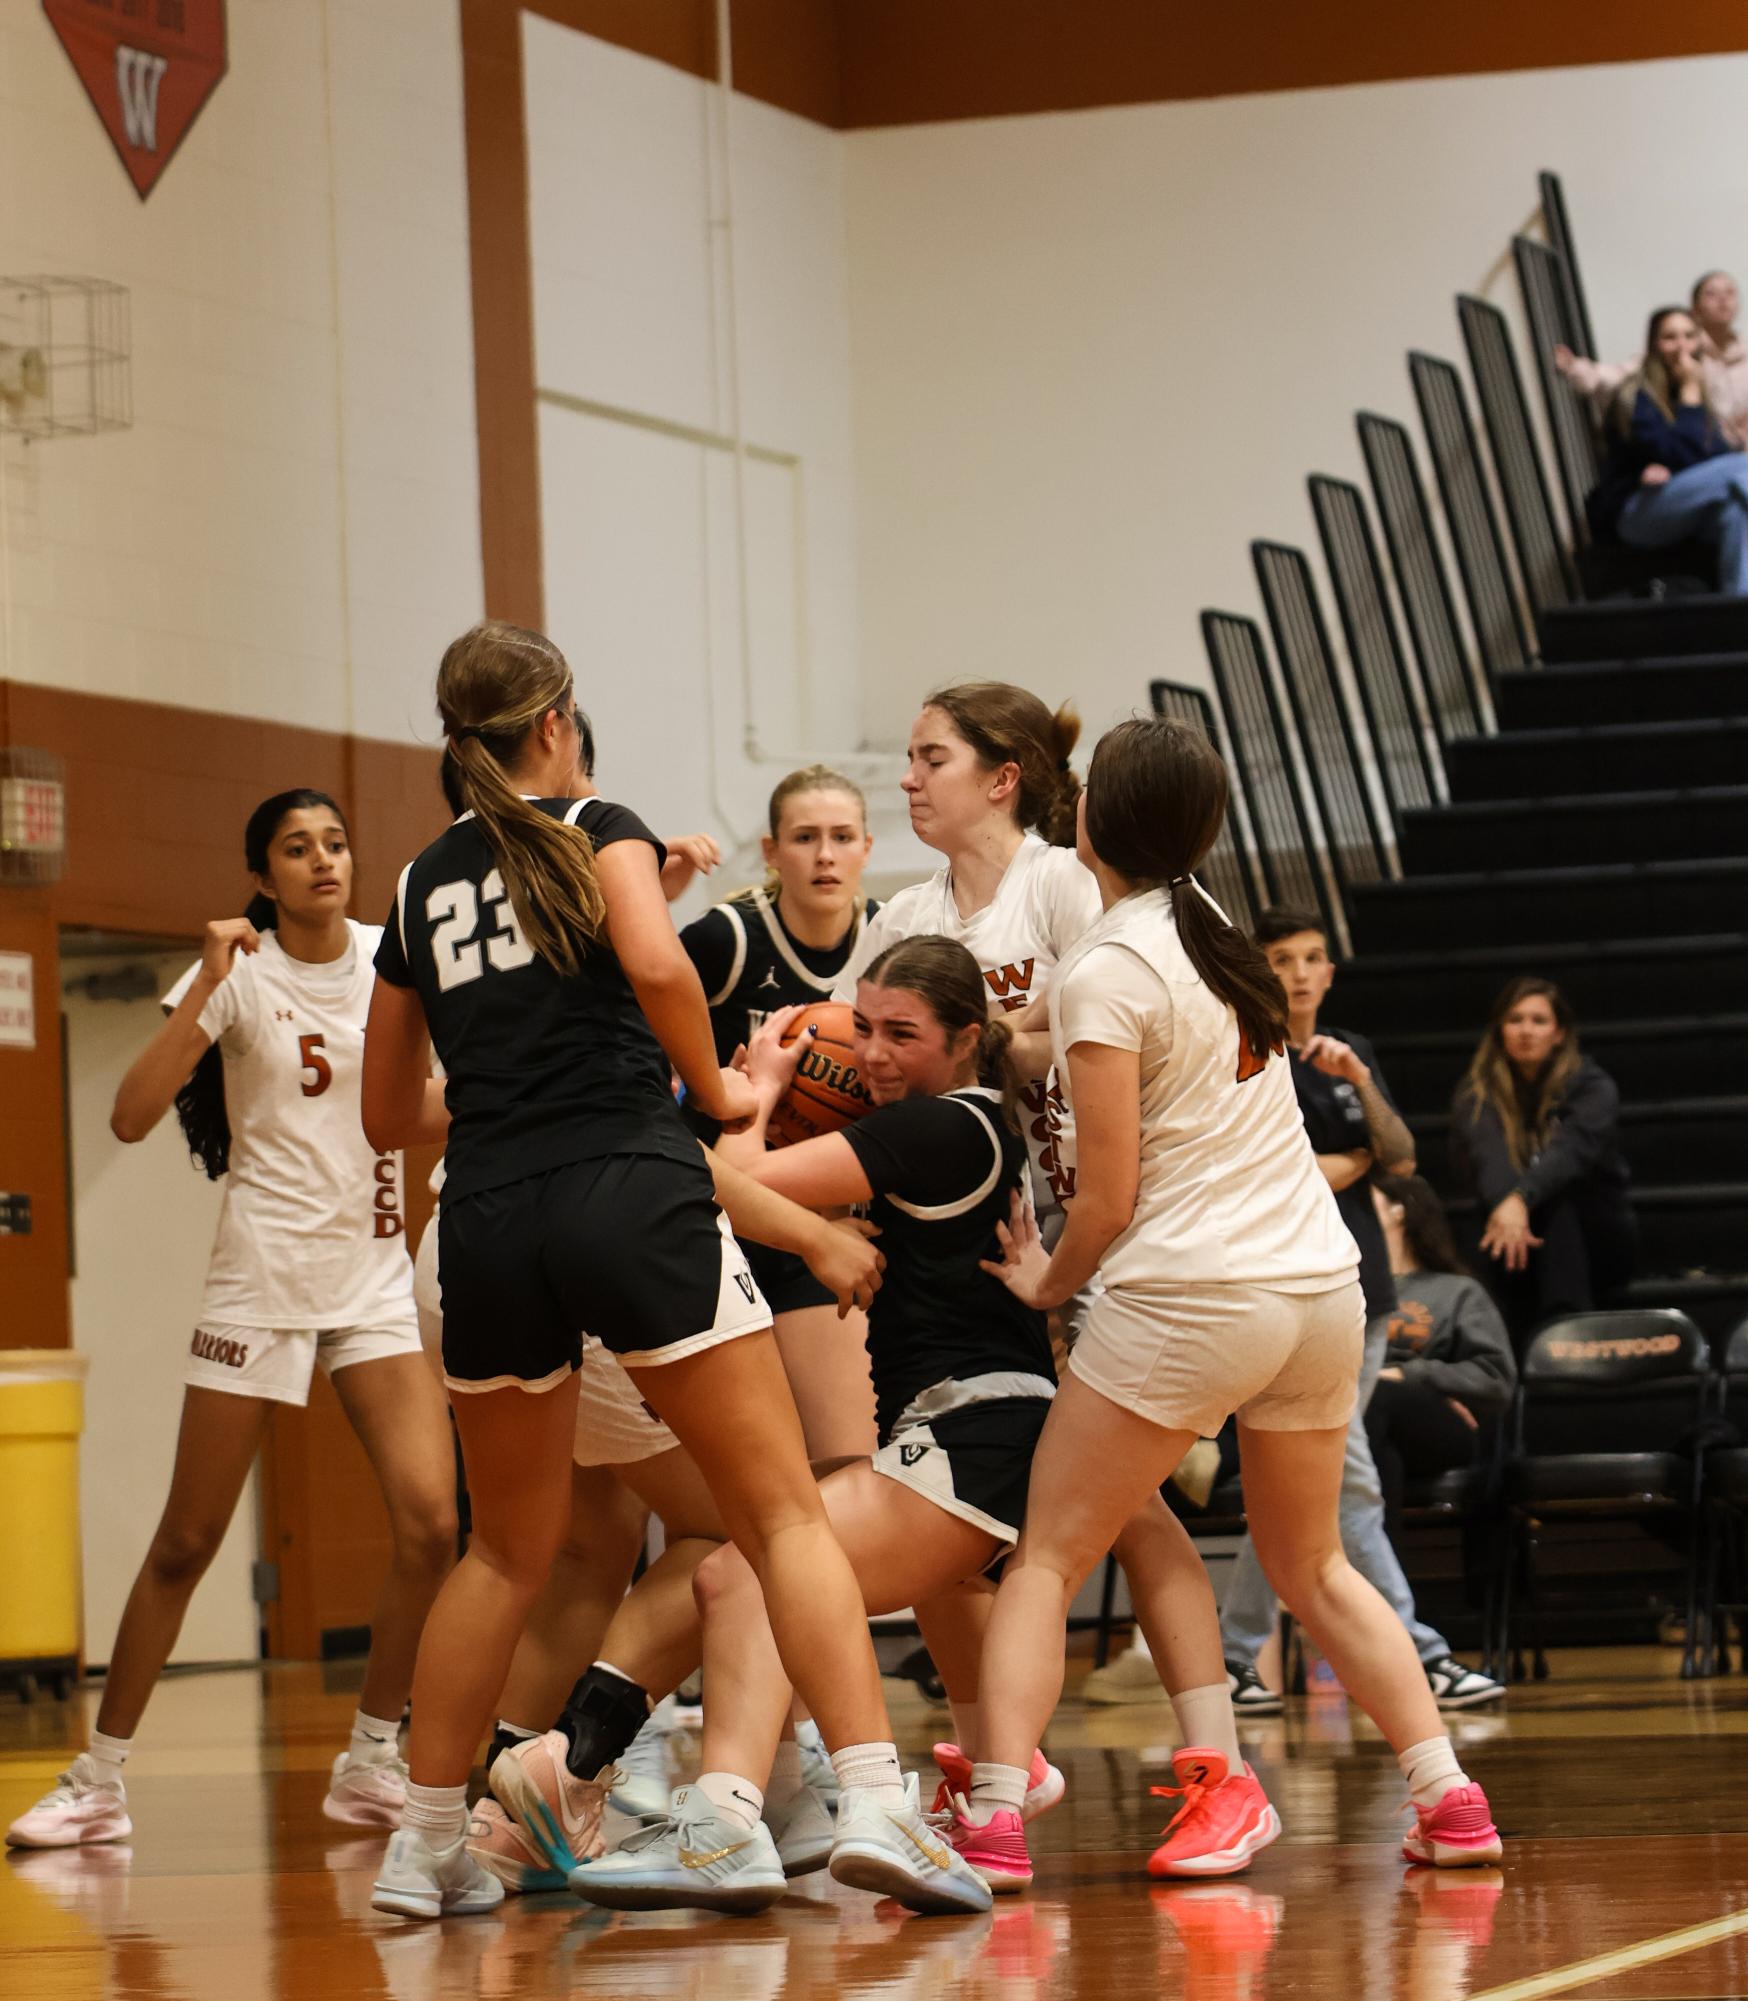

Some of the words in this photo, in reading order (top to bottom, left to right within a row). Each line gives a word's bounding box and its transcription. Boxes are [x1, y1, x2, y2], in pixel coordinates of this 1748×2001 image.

[115, 45, 168, 152] W
[425, 868, 537, 994] 23
[298, 1033, 333, 1098] 5
